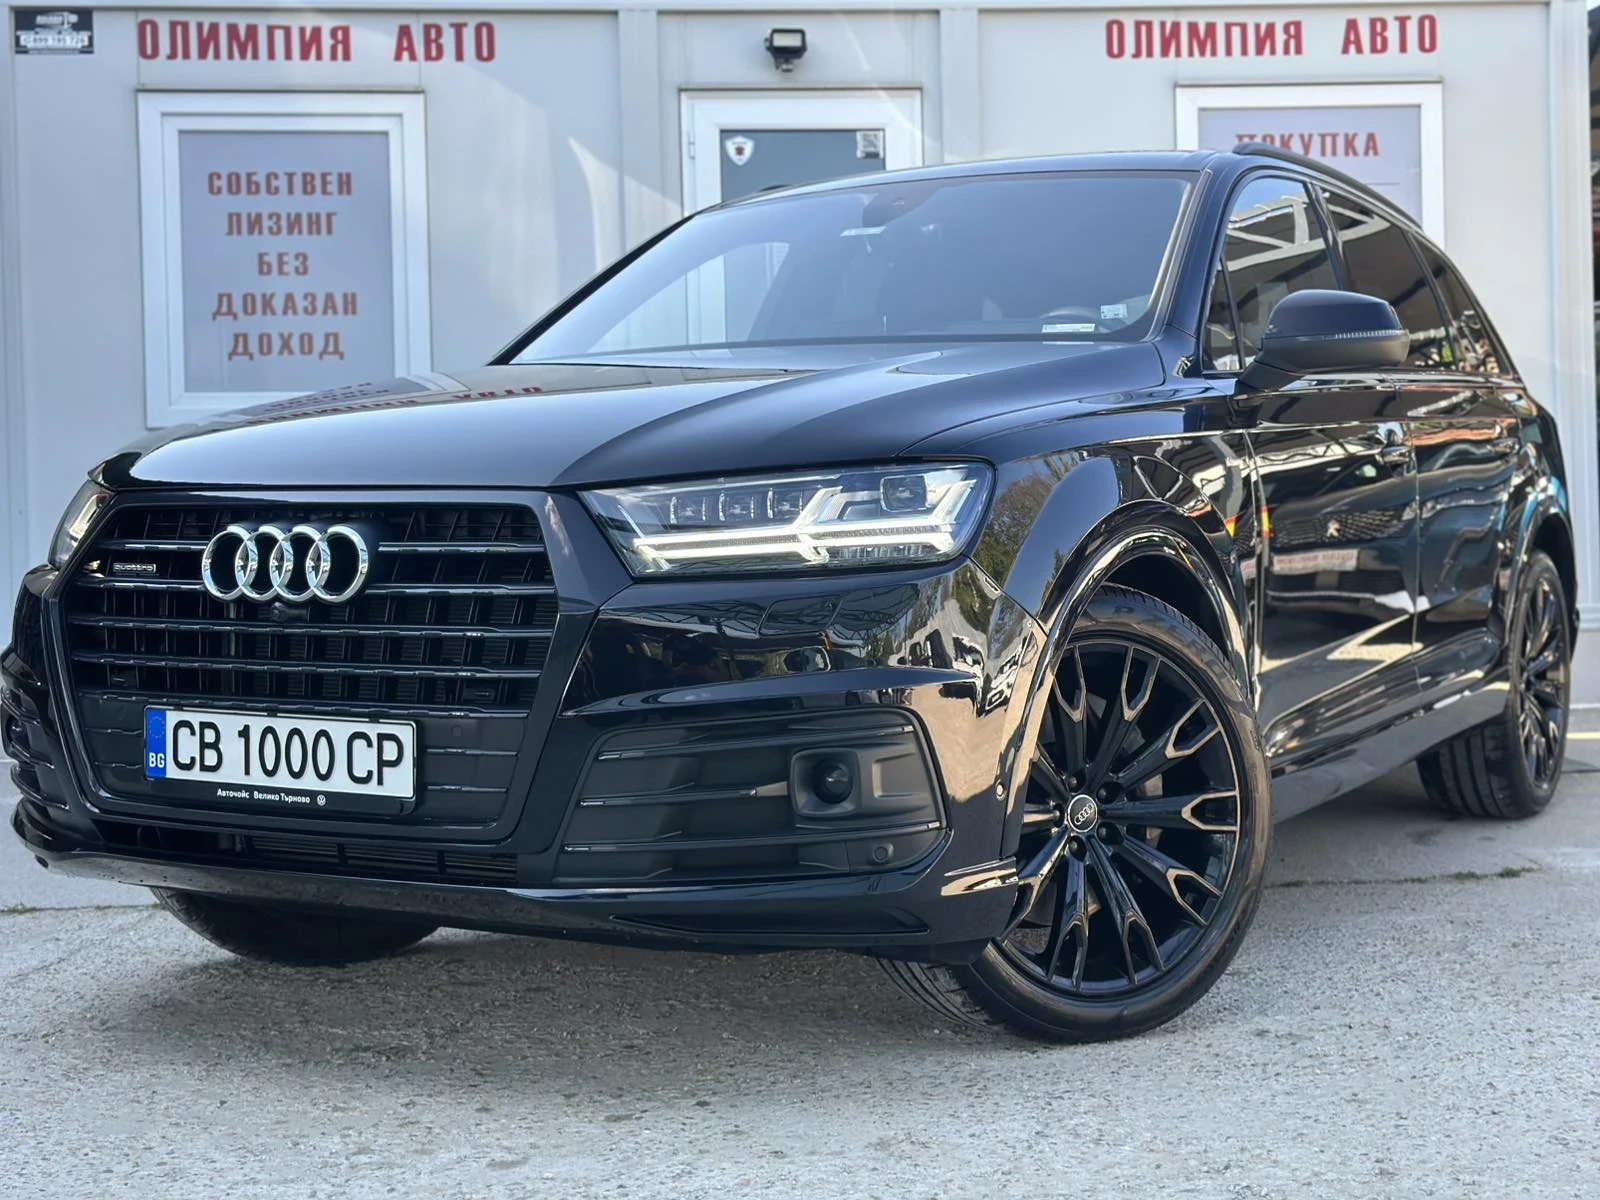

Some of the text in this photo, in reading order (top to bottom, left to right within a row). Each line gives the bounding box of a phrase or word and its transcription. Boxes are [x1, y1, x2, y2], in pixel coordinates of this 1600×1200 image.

[137, 18, 495, 62] ОЛИМПИЯ АВТО
[1105, 14, 1437, 59] ОЛИМПИЯ АВТО
[207, 171, 353, 196] СОБСТВЕН
[225, 211, 338, 237] ЛИЗИНГ
[257, 252, 309, 277] БЕЗ
[211, 292, 358, 322] ДОКАЗАН
[228, 332, 345, 361] ДОХОД
[149, 752, 165, 768] BG
[172, 719, 405, 787] CB 1000 CP
[217, 788, 311, 804] Авточойс Велико Търново
